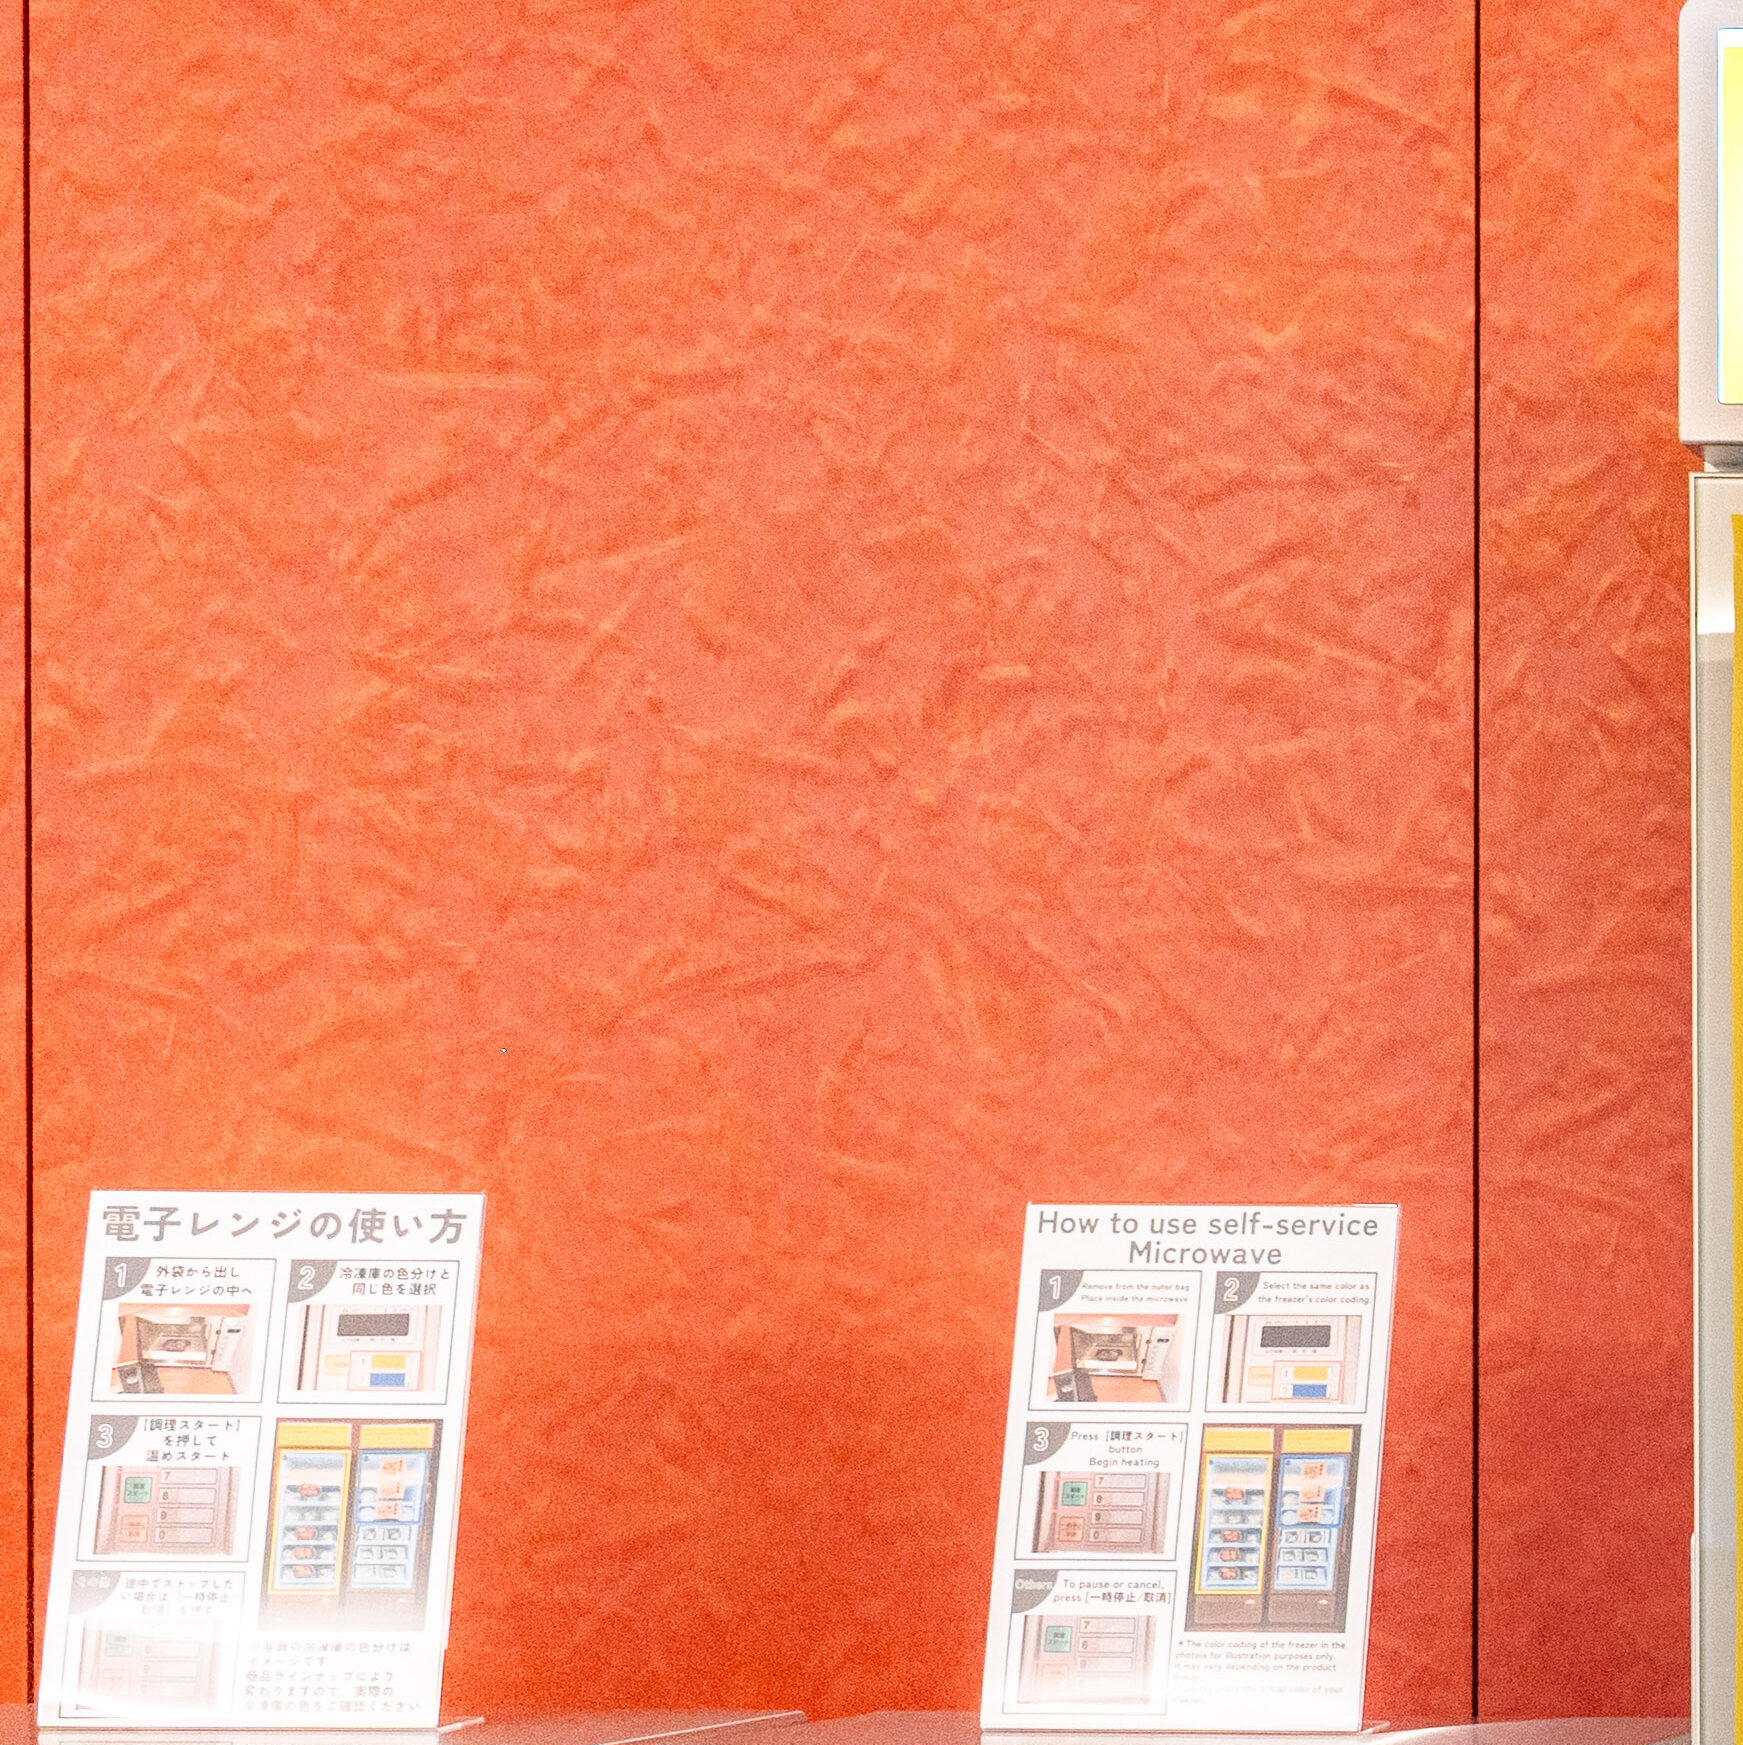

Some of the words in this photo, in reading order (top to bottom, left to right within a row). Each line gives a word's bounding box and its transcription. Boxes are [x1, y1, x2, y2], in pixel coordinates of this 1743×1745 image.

[102, 1205, 468, 1245] 電子レンジの使い方
[1037, 1211, 1099, 1235] How
[1110, 1214, 1139, 1235] to
[1149, 1218, 1198, 1235] use
[1207, 1211, 1379, 1236] self-service
[1128, 1241, 1283, 1265] Microwave
[156, 1265, 241, 1279] 外袋から出し
[338, 1266, 451, 1281] 冷凍庫の色分けと
[139, 1283, 253, 1297] 電子レンジの中へ
[1089, 1457, 1119, 1468] Begin
[1121, 1458, 1160, 1468] heating
